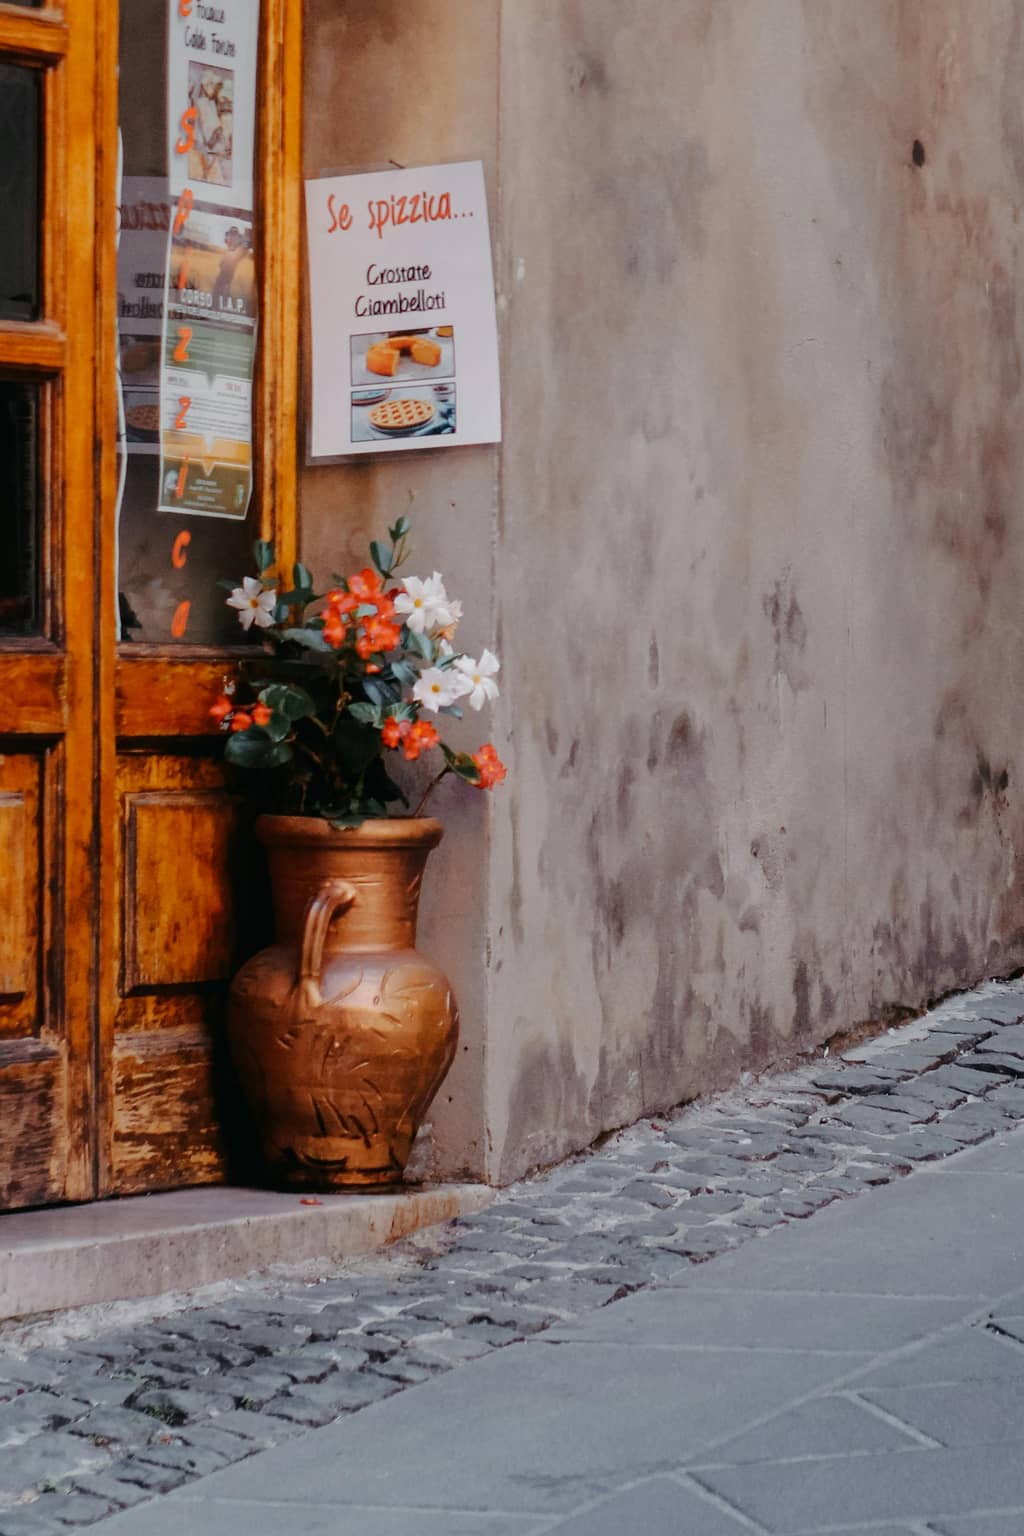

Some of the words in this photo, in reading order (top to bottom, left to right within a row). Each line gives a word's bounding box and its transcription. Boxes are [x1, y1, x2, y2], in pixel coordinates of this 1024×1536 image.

[327, 193, 353, 234] Se
[366, 263, 433, 286] Crostate
[180, 288, 213, 308] CORSO
